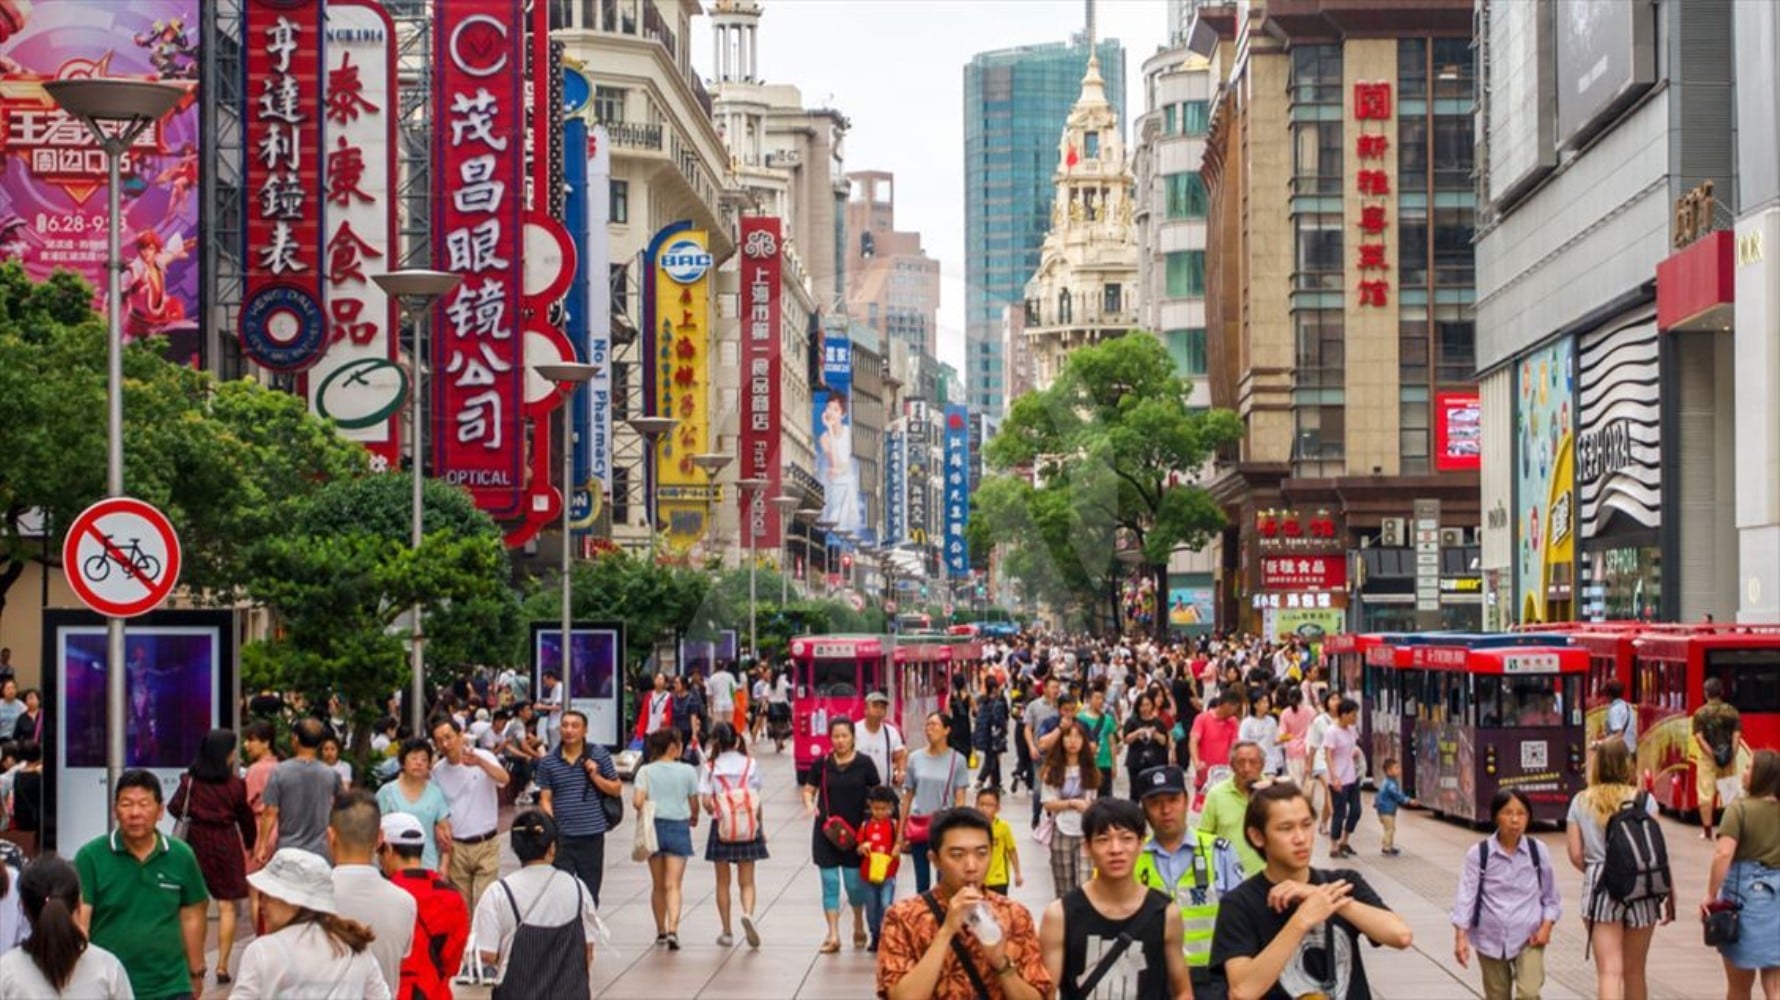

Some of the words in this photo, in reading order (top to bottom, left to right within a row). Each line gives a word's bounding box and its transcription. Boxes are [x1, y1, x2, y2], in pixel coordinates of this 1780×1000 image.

[356, 29, 383, 41] 1914
[257, 16, 308, 275] 亨達利鐘表
[326, 51, 383, 346] 泰康食品
[446, 87, 510, 449] 茂昌眼镜公司
[752, 266, 769, 431] 上海市第一食品商店
[447, 468, 511, 486] OPTICAL
[593, 390, 607, 479] Pharmacy
[1577, 419, 1631, 482] SEPHORA
